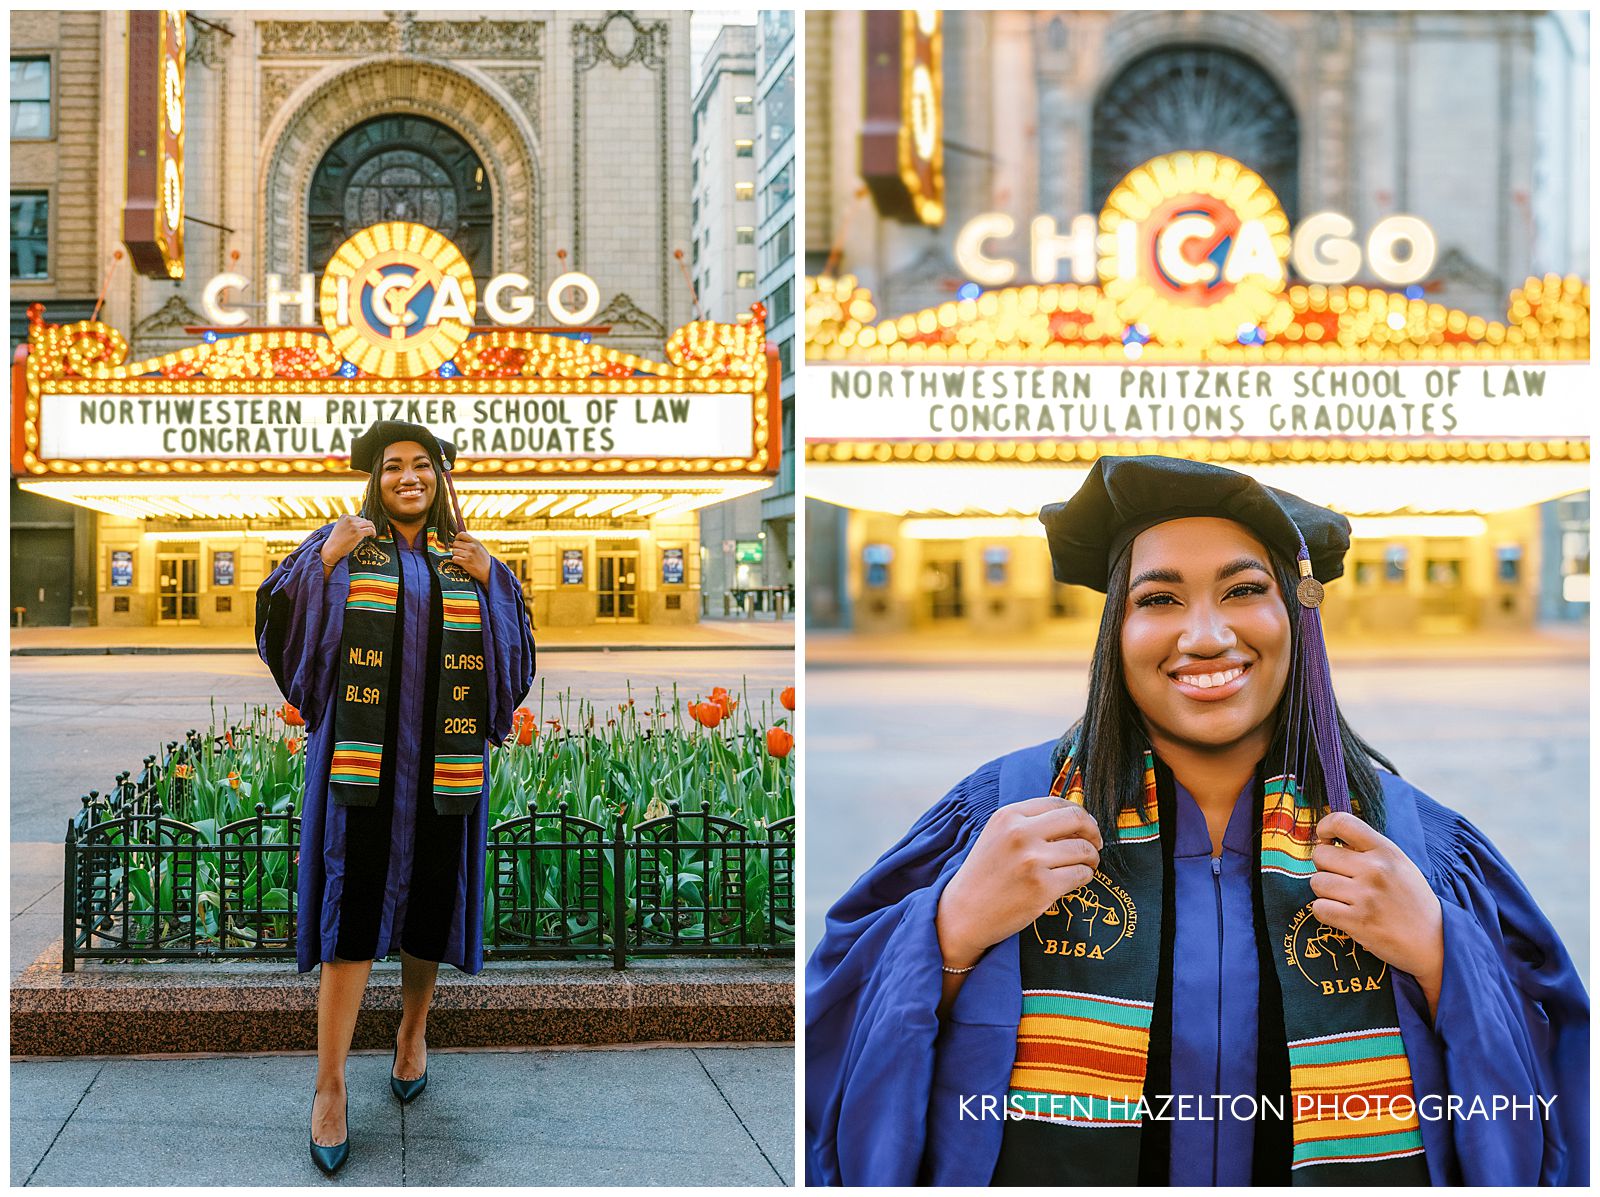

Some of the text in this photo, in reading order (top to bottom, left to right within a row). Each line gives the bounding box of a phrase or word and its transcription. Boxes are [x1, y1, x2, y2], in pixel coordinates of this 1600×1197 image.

[955, 211, 1437, 286] CHICAGO
[202, 273, 600, 326] CHICAGO
[831, 369, 1546, 399] NORTHWESTERN PRITZKER SCHOOL OF LAW
[80, 399, 690, 424] NORTHWESTERN PRITZKER SCHOOL OF LAW
[929, 403, 1457, 433] CONGRATULATIONS GRADUATES
[453, 427, 615, 452] GRADUATES
[349, 647, 383, 668] NLAW
[444, 654, 484, 671] CLASS
[345, 684, 380, 705] BLSA
[453, 686, 470, 701] OF
[444, 717, 477, 735] 2025
[1112, 885, 1137, 938] ASSOCIATION
[1284, 908, 1306, 966] BLACK LAW
[1044, 940, 1105, 960] BLSA
[1320, 976, 1381, 995] BLSA
